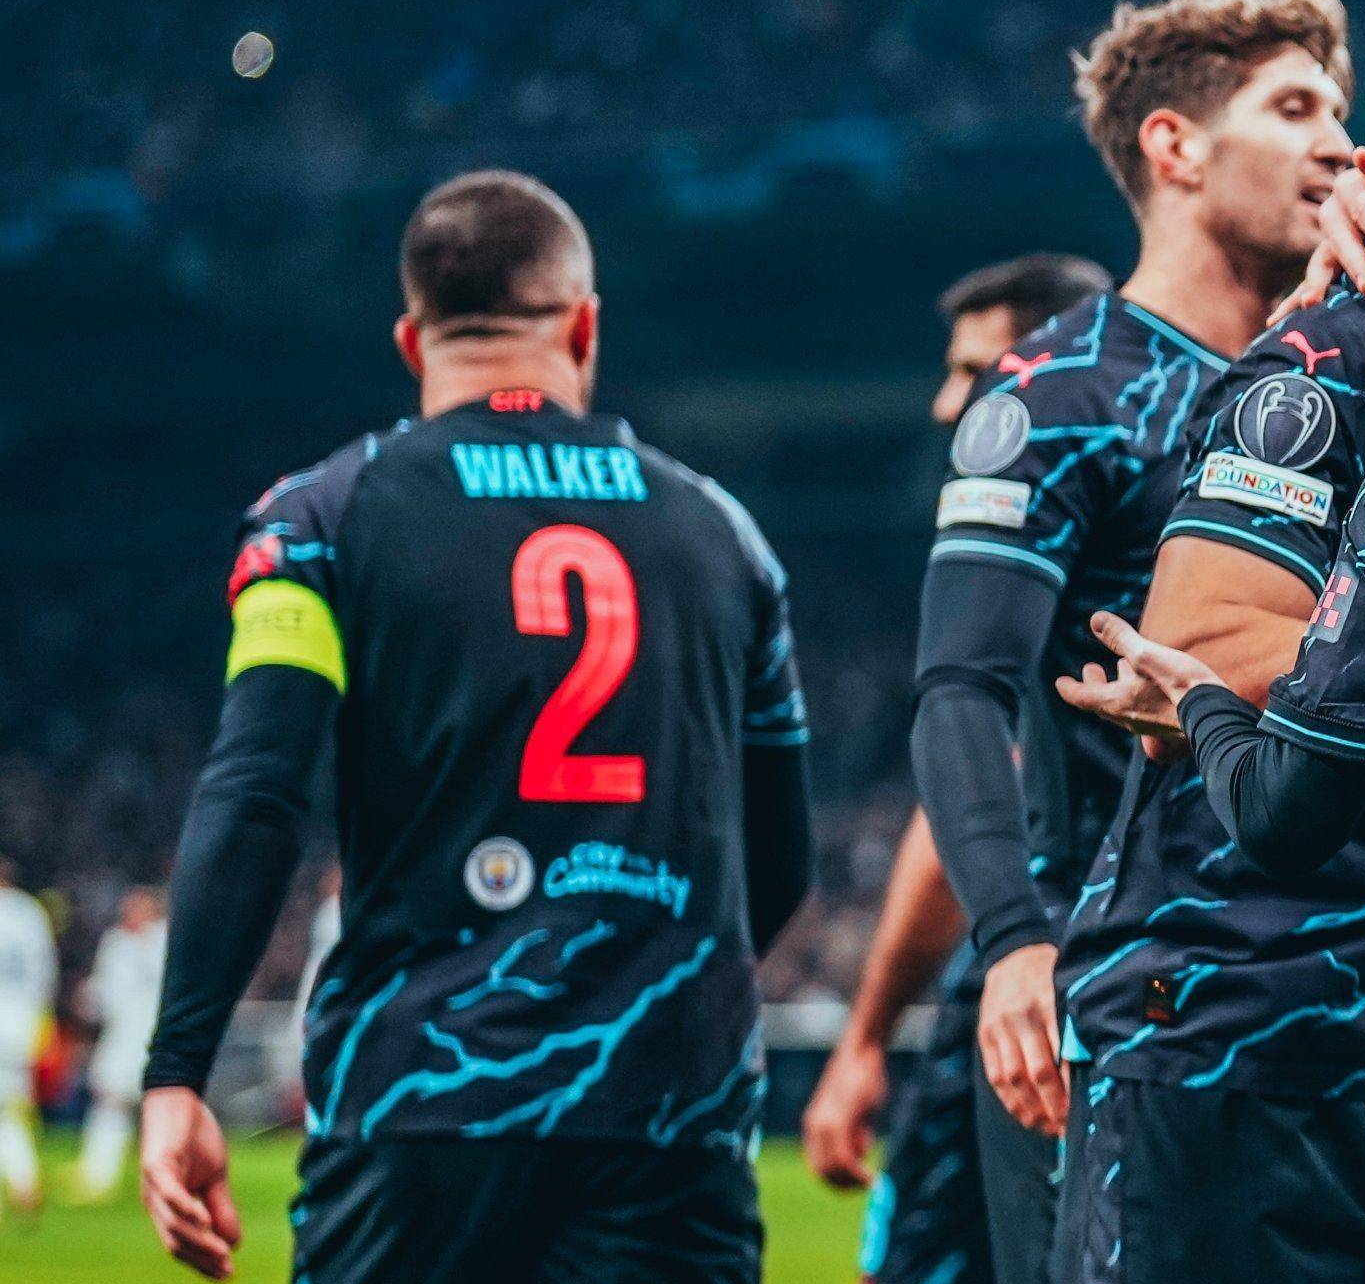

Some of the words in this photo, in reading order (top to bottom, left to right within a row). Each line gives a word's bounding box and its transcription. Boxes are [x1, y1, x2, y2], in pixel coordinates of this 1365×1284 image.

[450, 443, 649, 503] WALKER
[1206, 464, 1328, 510] FOUNDATION
[511, 523, 647, 803] 2
